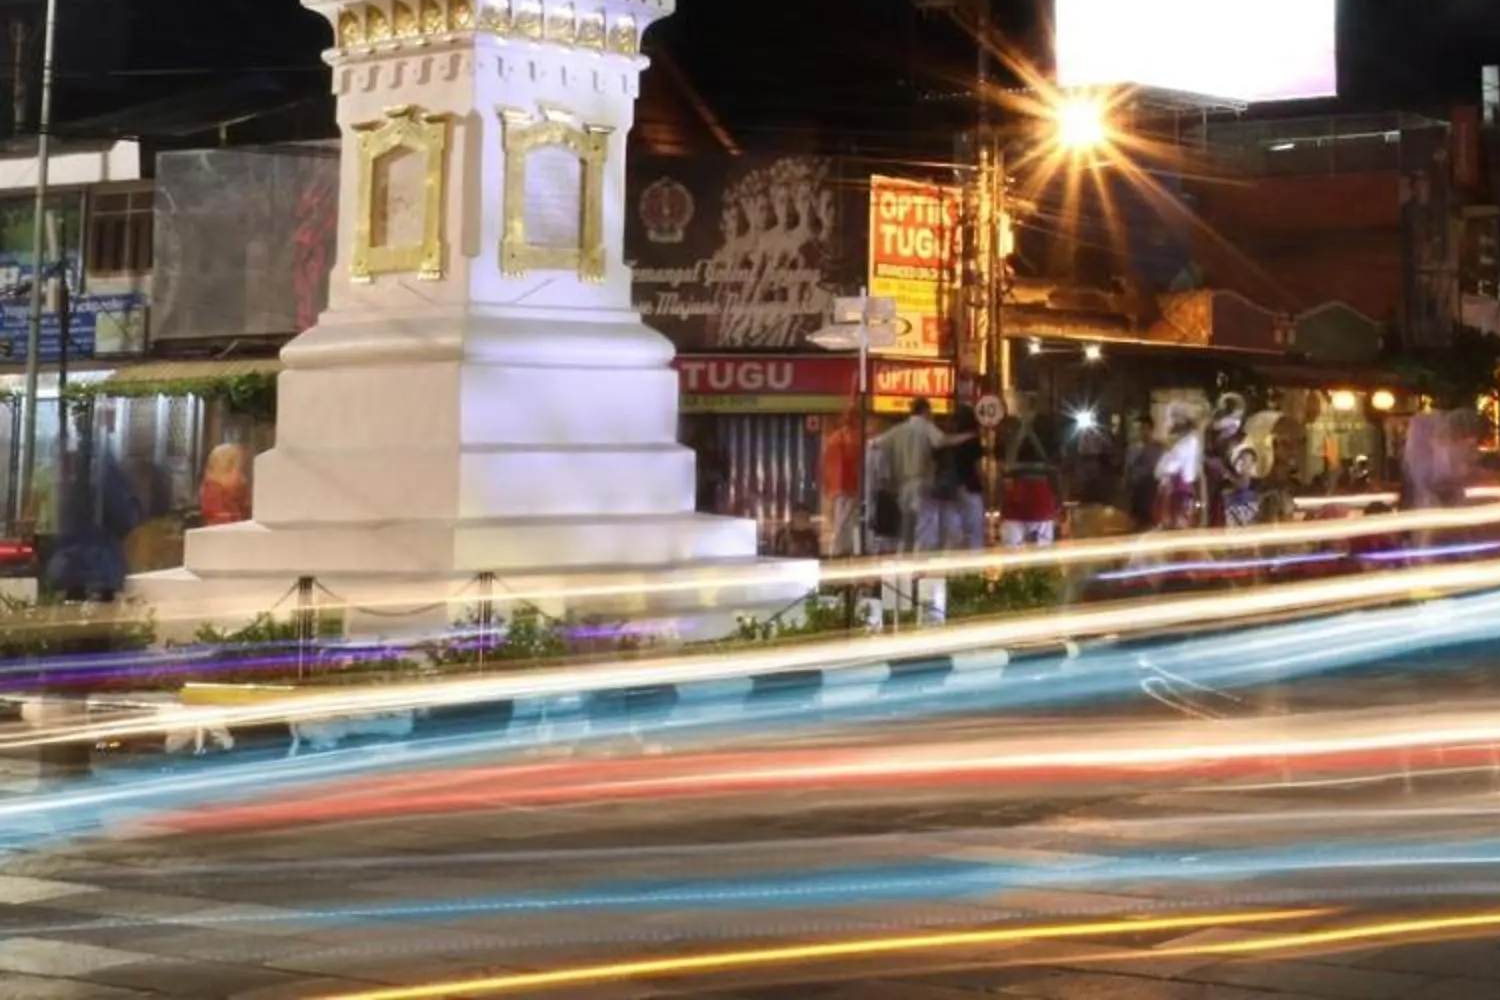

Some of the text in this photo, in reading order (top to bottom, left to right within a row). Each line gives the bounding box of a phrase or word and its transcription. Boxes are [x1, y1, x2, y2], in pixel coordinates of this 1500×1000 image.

[880, 190, 953, 227] OPTIK
[881, 222, 951, 262] TUGU
[681, 361, 794, 389] TUGU
[877, 366, 930, 393] OPTIK
[979, 402, 996, 418] 40
